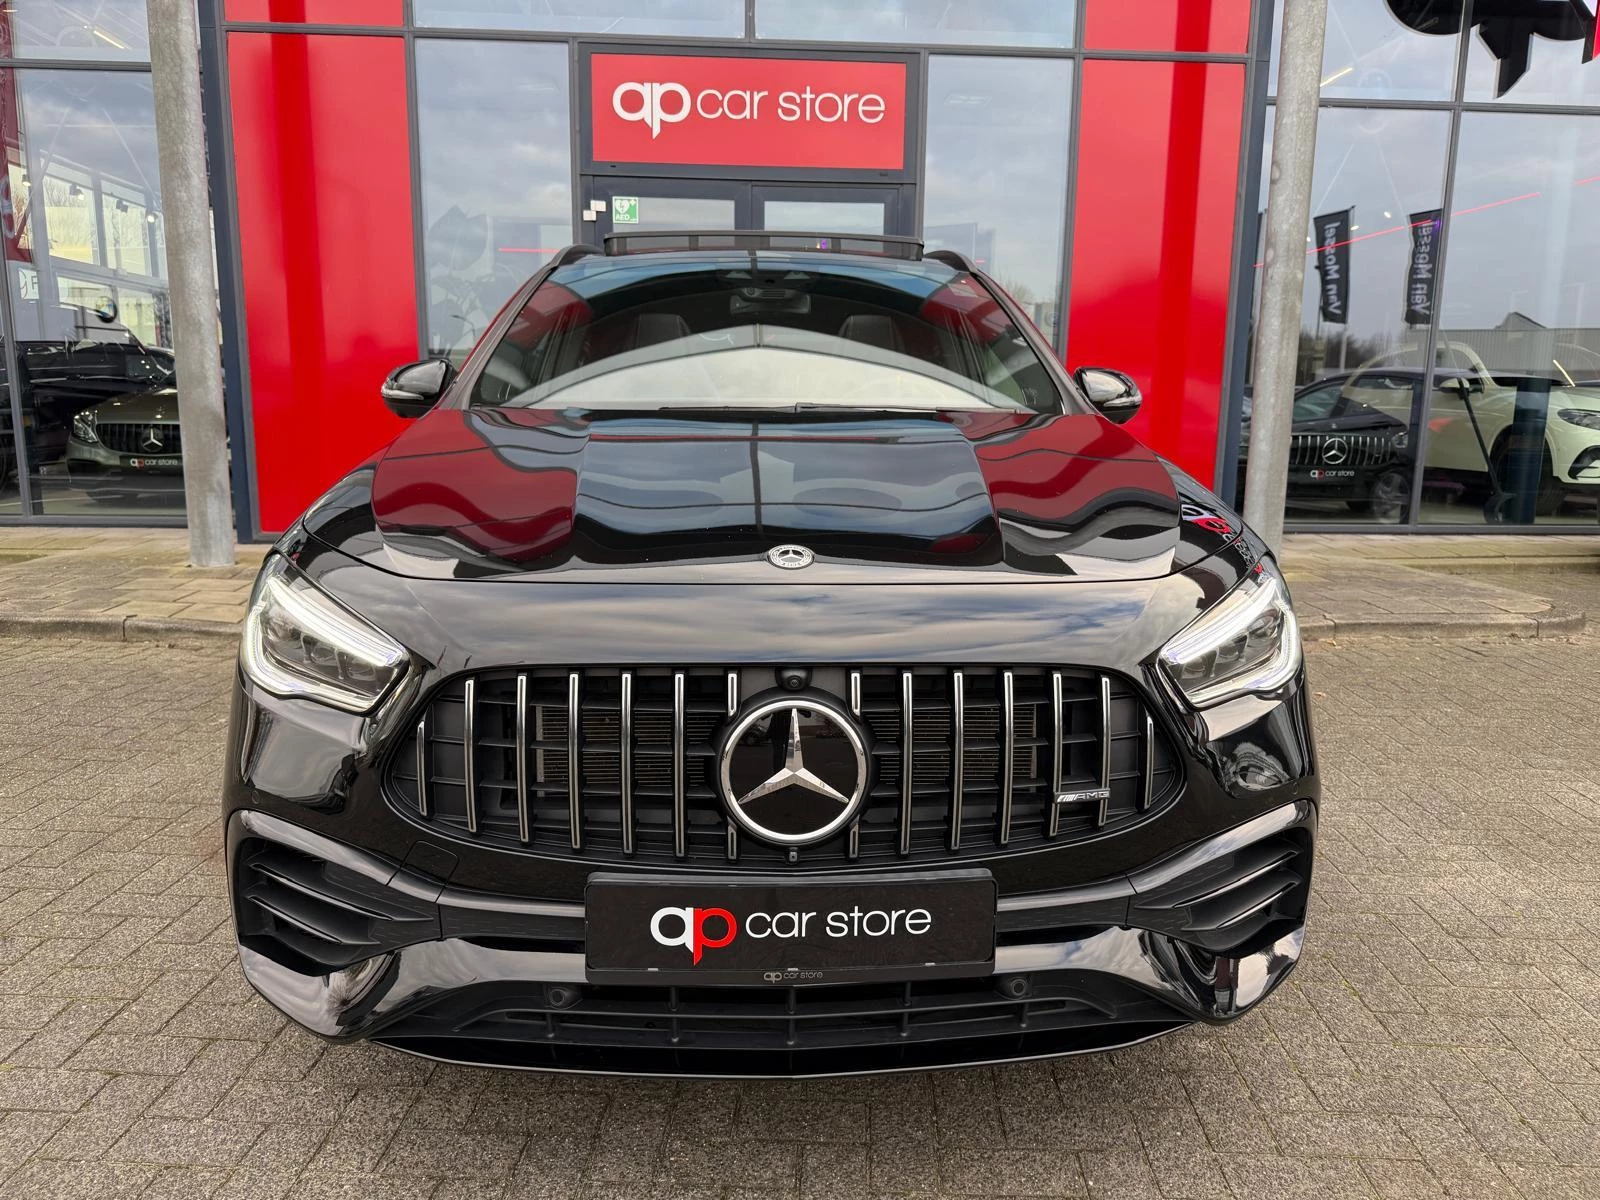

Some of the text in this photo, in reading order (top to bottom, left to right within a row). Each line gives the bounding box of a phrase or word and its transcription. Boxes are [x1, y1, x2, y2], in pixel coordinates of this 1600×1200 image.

[612, 81, 885, 139] ap car store
[1075, 791, 1110, 800] AMG
[650, 905, 931, 966] ap car store
[800, 971, 823, 979] store
